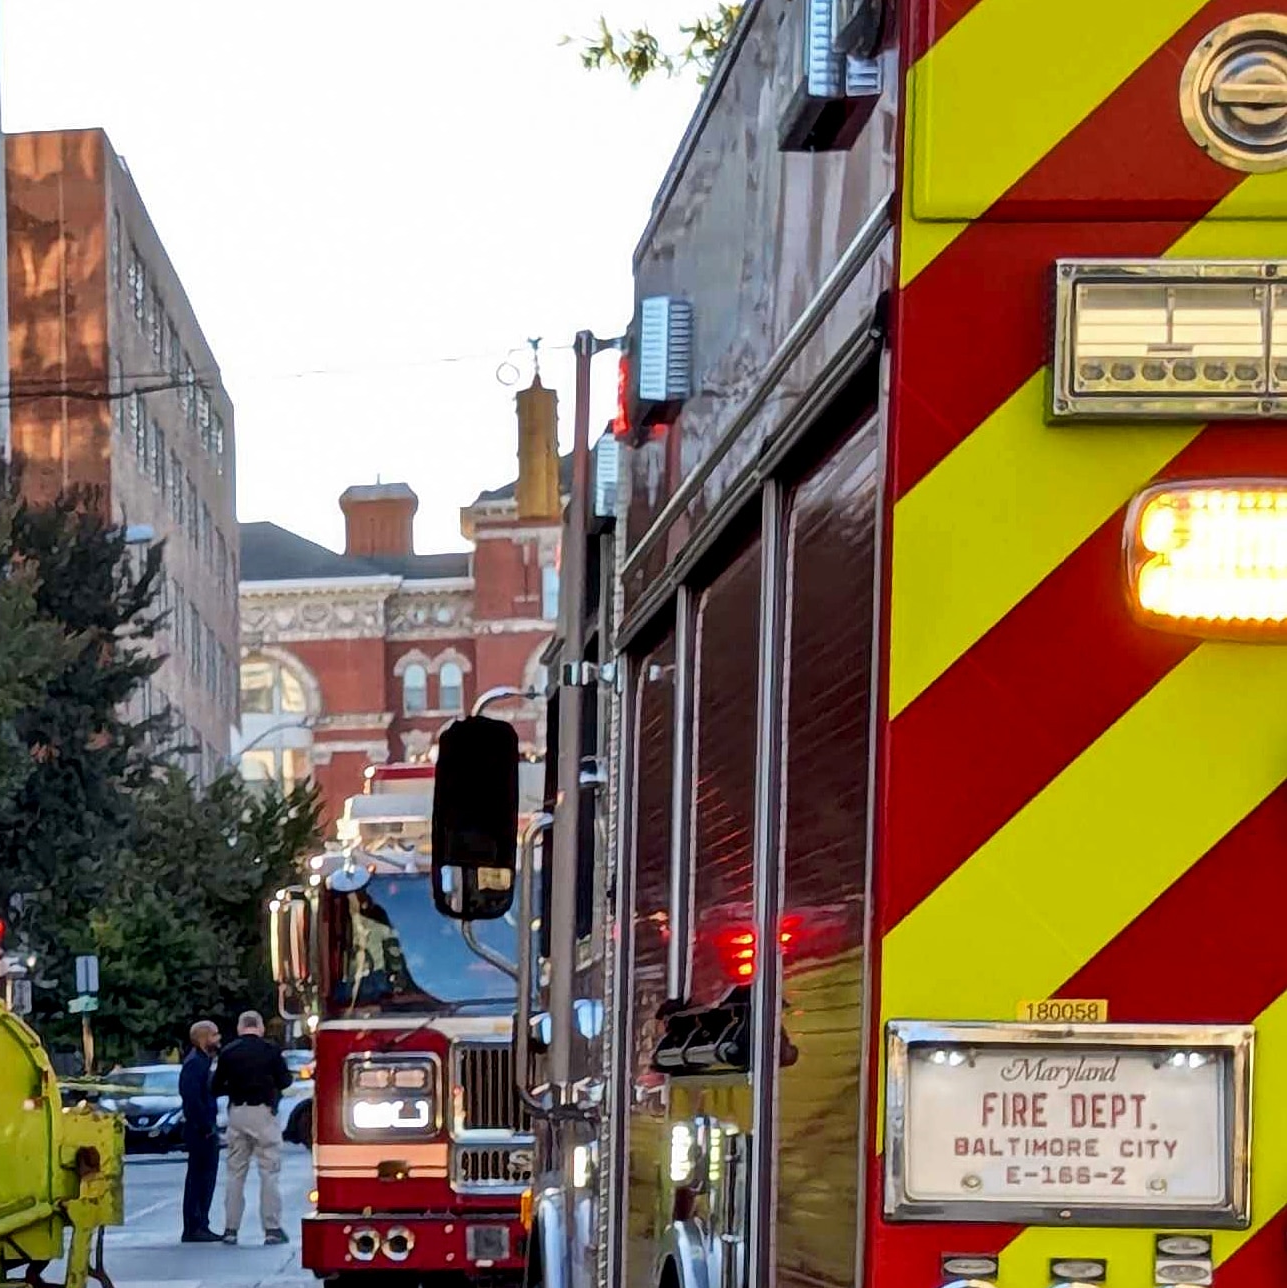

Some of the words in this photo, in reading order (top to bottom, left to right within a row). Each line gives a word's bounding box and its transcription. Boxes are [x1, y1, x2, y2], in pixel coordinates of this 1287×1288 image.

[1026, 1002, 1098, 1021] 180058
[1000, 1055, 1121, 1089] Maryland
[980, 1091, 1048, 1129] FIRE
[1070, 1092, 1159, 1131] DEPT.
[953, 1136, 1099, 1158] BALTIMORE
[1119, 1138, 1179, 1160] CITY
